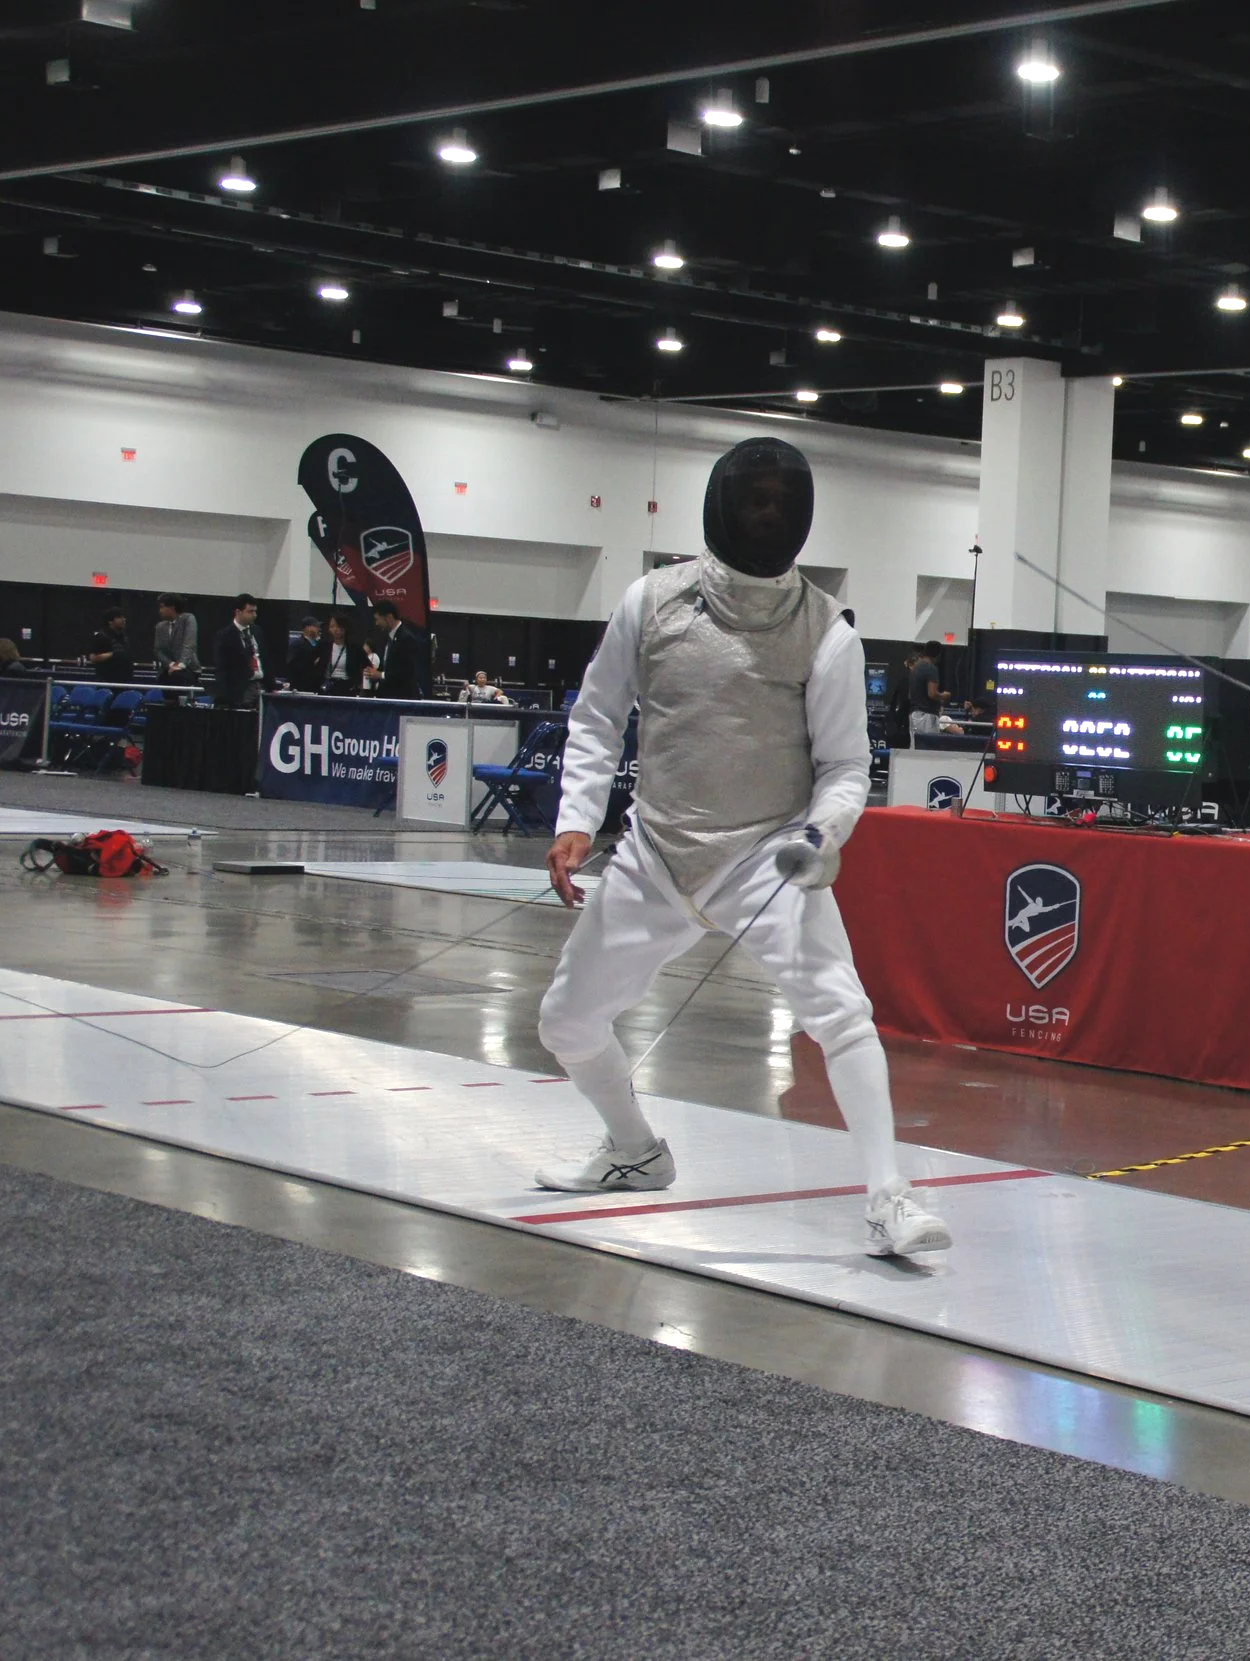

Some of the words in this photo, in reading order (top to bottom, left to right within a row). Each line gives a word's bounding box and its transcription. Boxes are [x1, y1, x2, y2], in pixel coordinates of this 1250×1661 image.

[990, 369, 1016, 402] B3
[375, 588, 407, 597] USA
[0, 712, 29, 727] USA
[269, 721, 330, 777] GH
[331, 731, 380, 764] Group
[332, 762, 346, 779] We
[350, 765, 373, 781] make
[426, 793, 445, 801] USA
[1006, 1003, 1070, 1026] USA
[1012, 1028, 1062, 1042] FENCING
